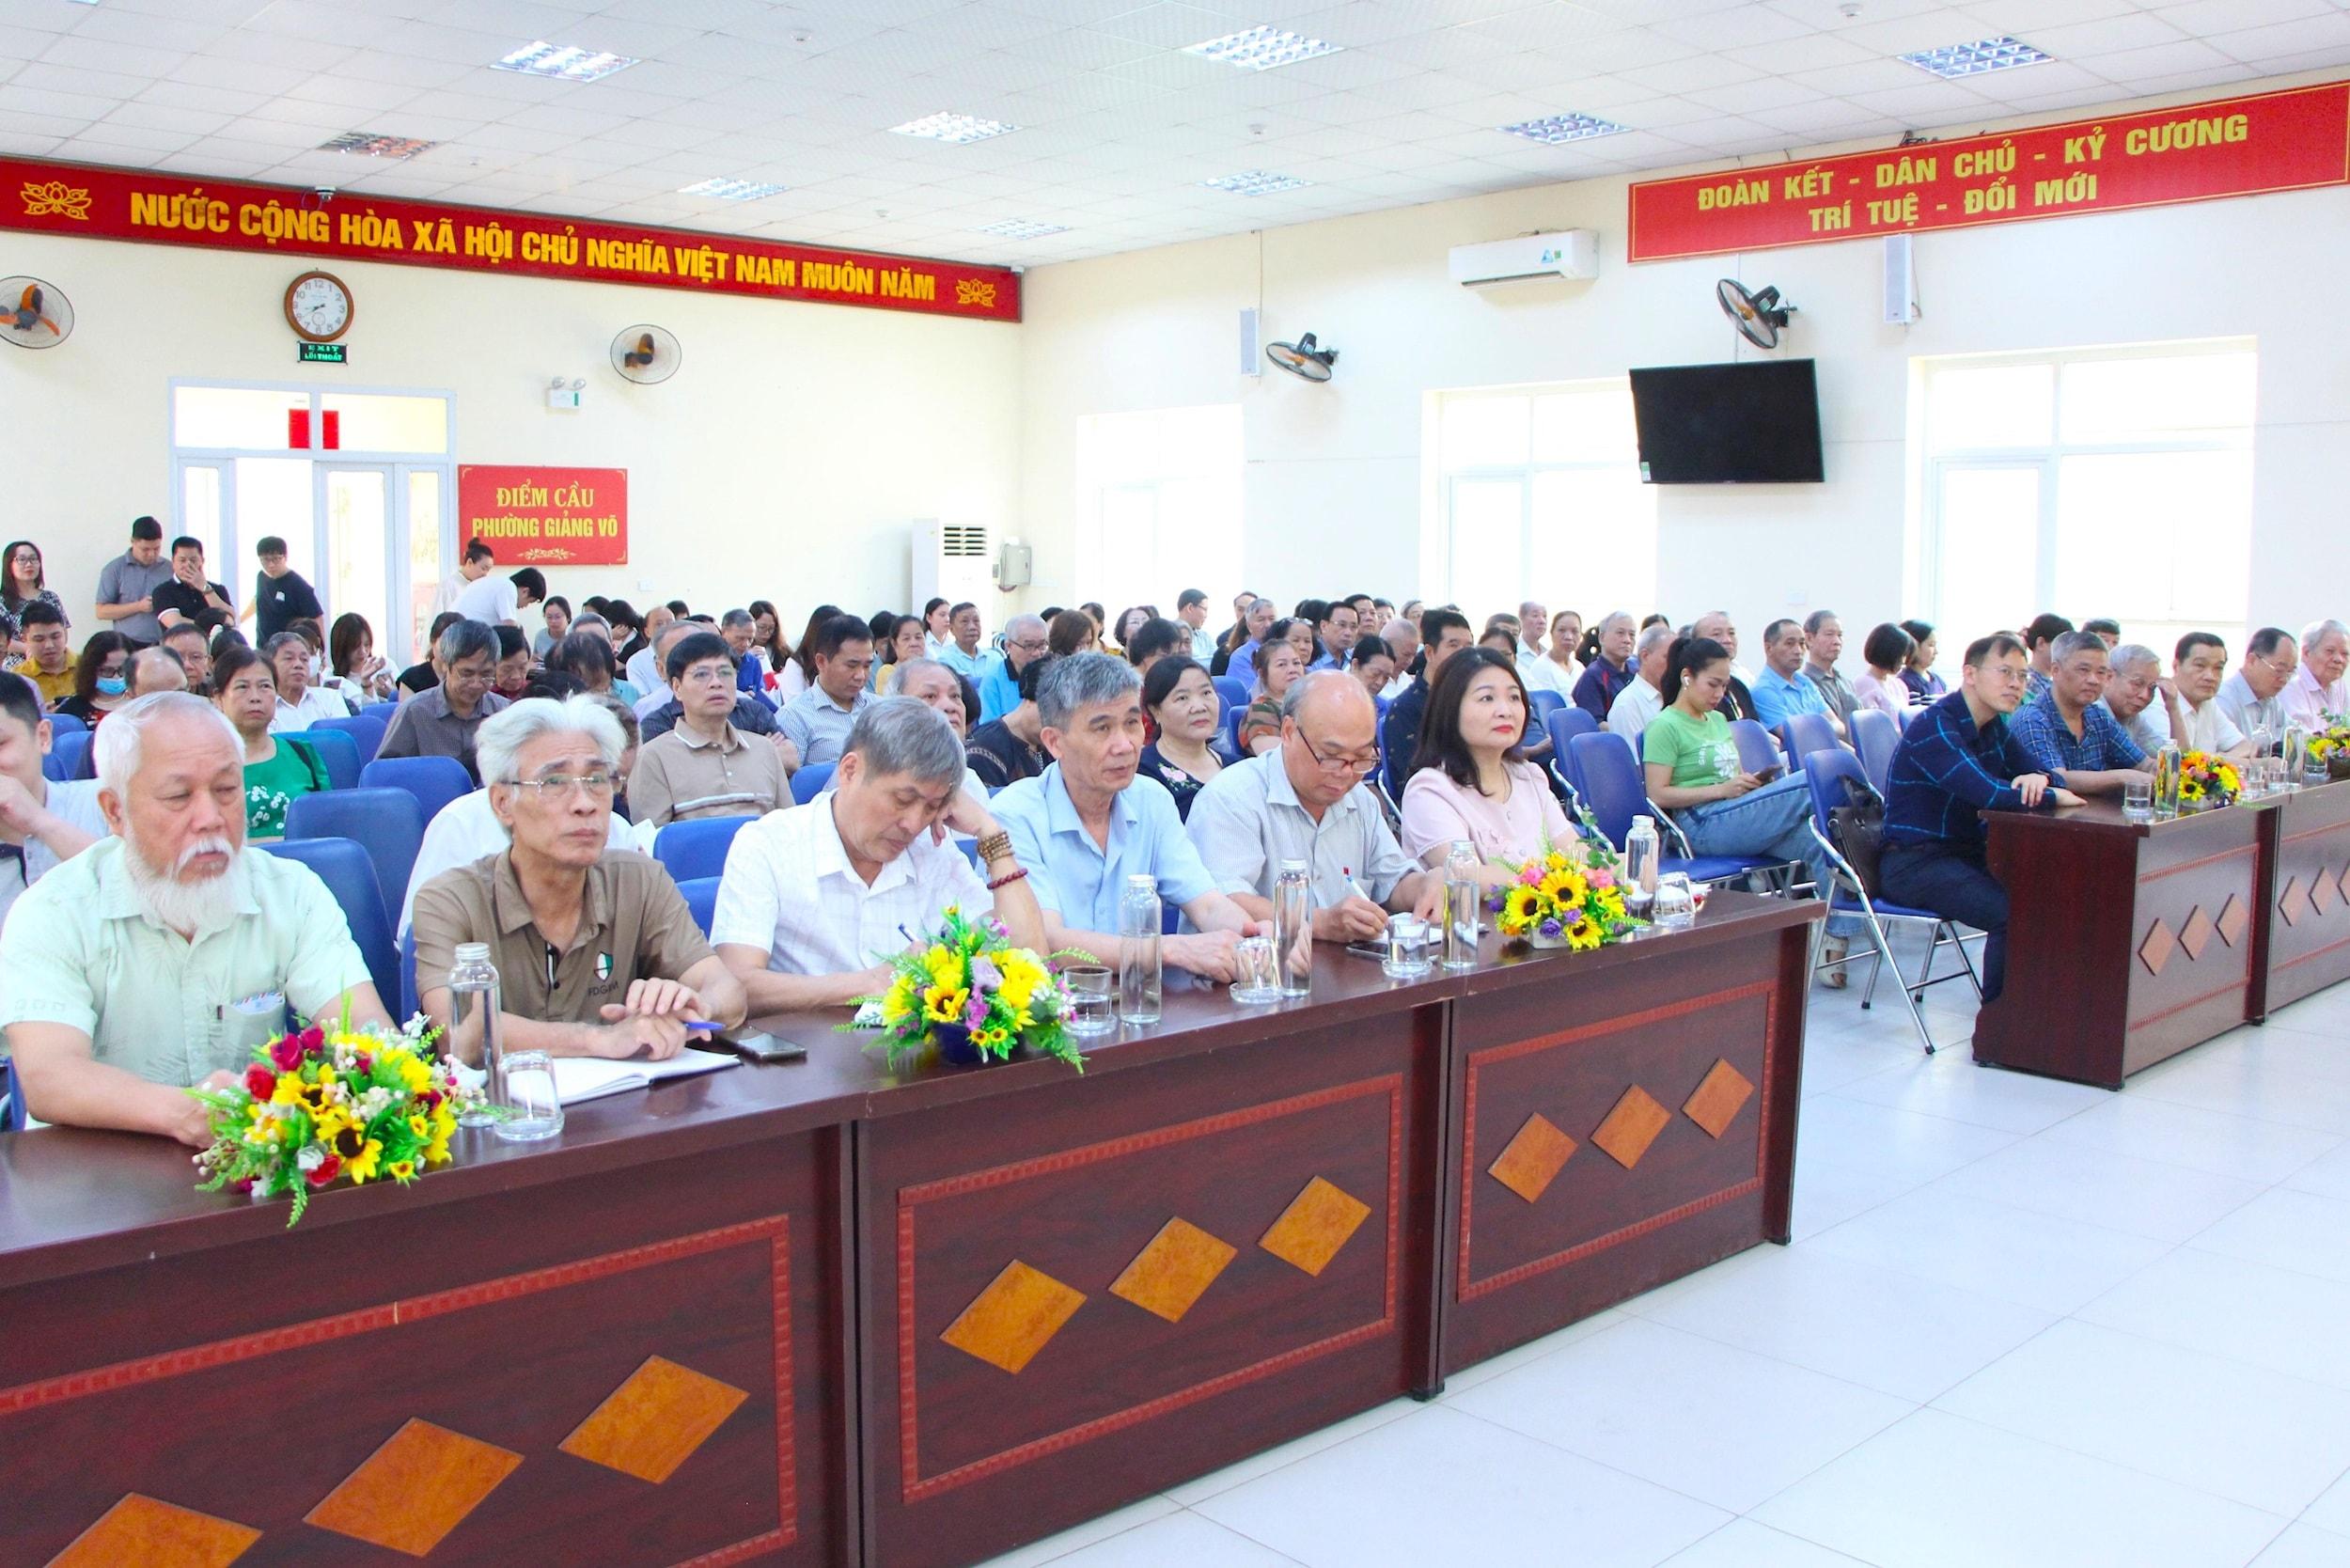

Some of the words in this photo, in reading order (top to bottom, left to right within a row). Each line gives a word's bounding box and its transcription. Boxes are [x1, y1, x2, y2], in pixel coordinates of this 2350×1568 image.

[1698, 178, 1769, 211] ĐOÀN
[1785, 164, 1834, 200] KẾT
[1876, 155, 1937, 188] DÂN
[1954, 138, 2016, 181] CHỦ
[2065, 125, 2105, 165] KỶ
[2126, 113, 2248, 155] CƯƠNG
[1809, 200, 1852, 232] TRÍ
[1867, 192, 1919, 227] TUỆ
[1965, 176, 2016, 215] ĐỔI
[2034, 171, 2097, 206] MỚI
[131, 188, 229, 232] NƯỚC
[240, 200, 330, 244] CỘNG
[340, 210, 401, 248] HÒA
[414, 217, 456, 254] XÃ
[465, 222, 512, 264] HỘI
[522, 226, 578, 265] CHỦ
[587, 239, 670, 274] NGHĨA
[675, 244, 728, 283] VIỆT
[736, 254, 794, 286] NAM
[803, 260, 873, 294] MUÔN
[881, 267, 935, 300] NĂM
[472, 513, 540, 537] PHƯỜNG
[544, 510, 593, 537] GIẢNG
[598, 515, 619, 537] VÕ
[496, 478, 548, 508] ĐIỂM
[554, 481, 594, 507] CẦU
